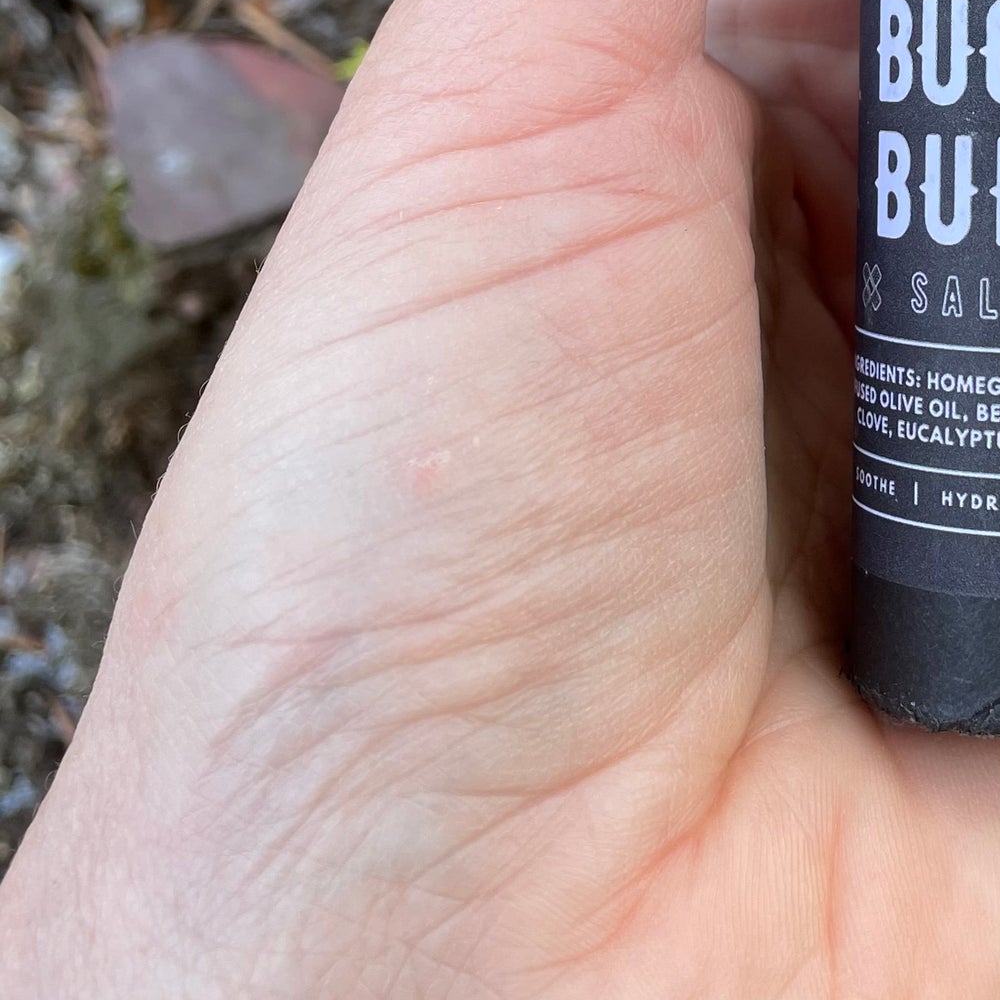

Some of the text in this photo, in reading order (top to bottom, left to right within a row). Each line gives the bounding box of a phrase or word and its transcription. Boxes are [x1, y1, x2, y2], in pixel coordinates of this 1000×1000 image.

[880, 390, 923, 414] OLIVE
[929, 399, 968, 422] OIL,
[858, 407, 892, 438] CLOVE,
[856, 466, 895, 495] SOOTHE
